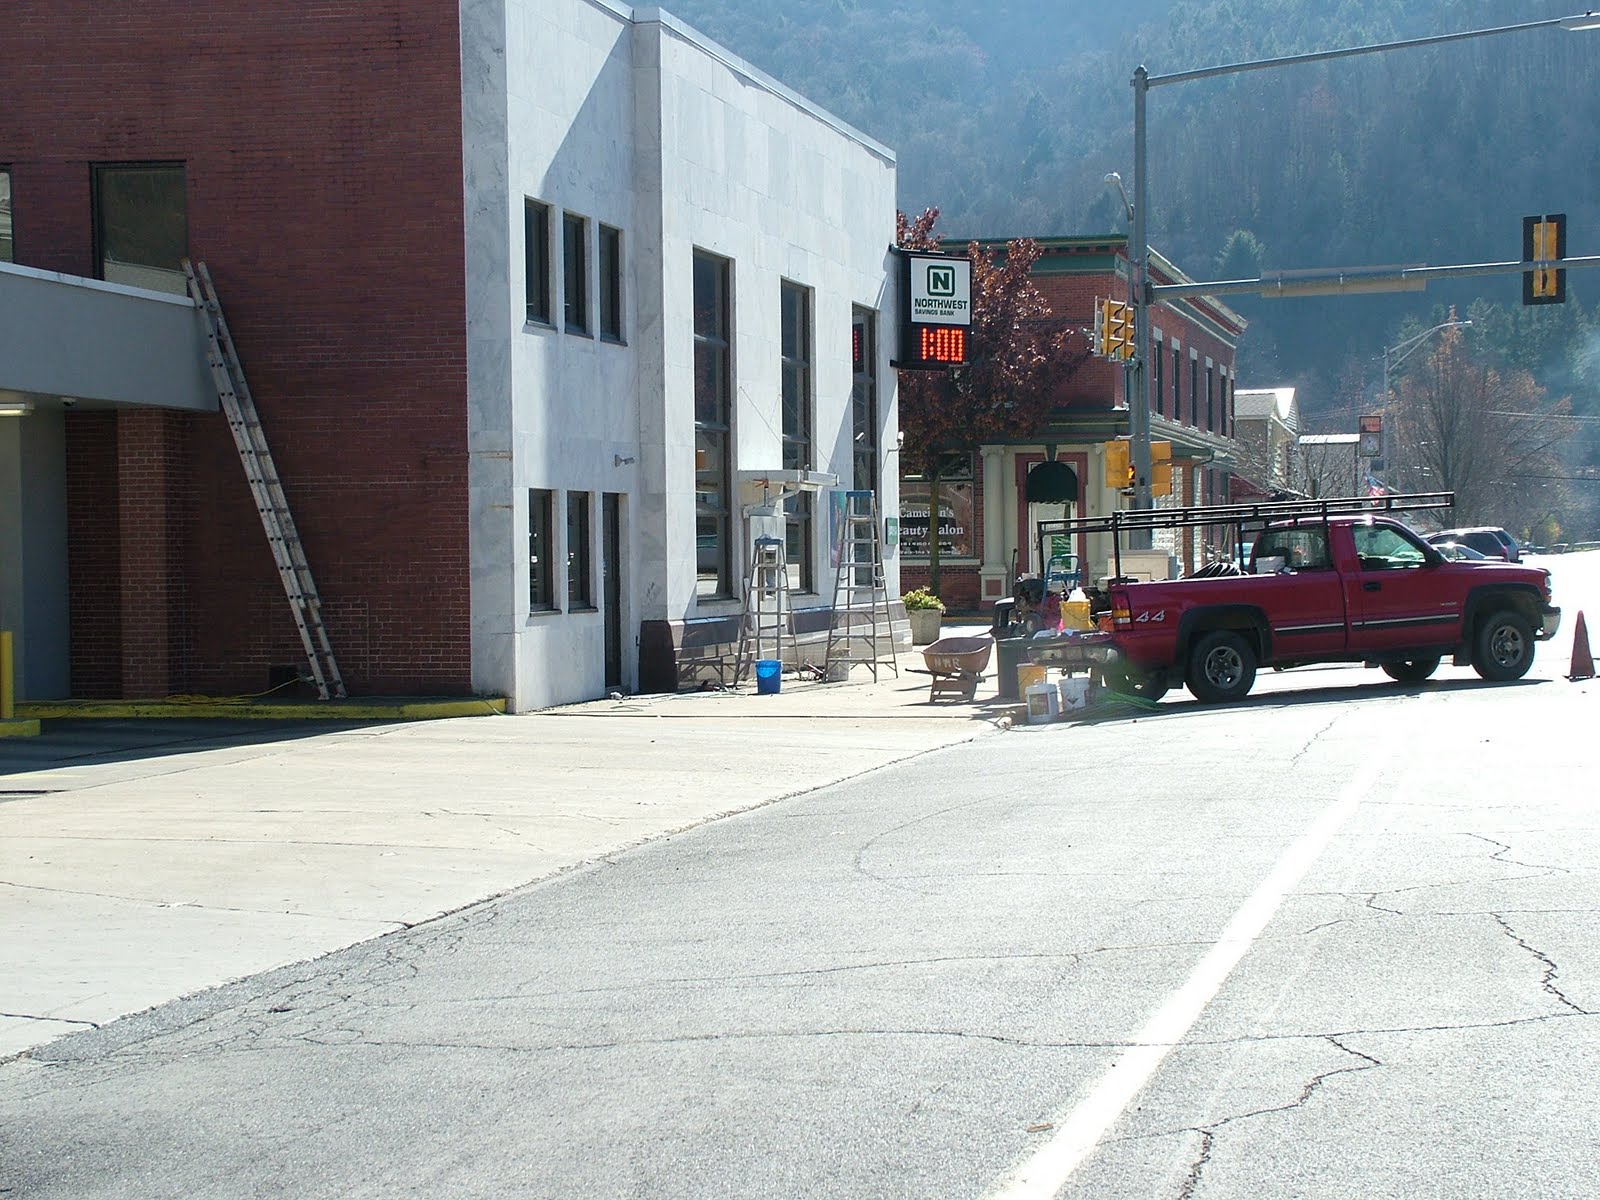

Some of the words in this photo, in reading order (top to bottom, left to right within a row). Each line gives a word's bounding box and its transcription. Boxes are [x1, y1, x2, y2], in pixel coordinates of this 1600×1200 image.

[933, 272, 950, 290] N
[914, 298, 968, 309] NORTHWEST
[939, 309, 955, 317] BANK
[922, 327, 963, 361] 1:00
[899, 507, 954, 518] Camen's
[899, 525, 929, 538] eauty
[938, 524, 964, 535] alon
